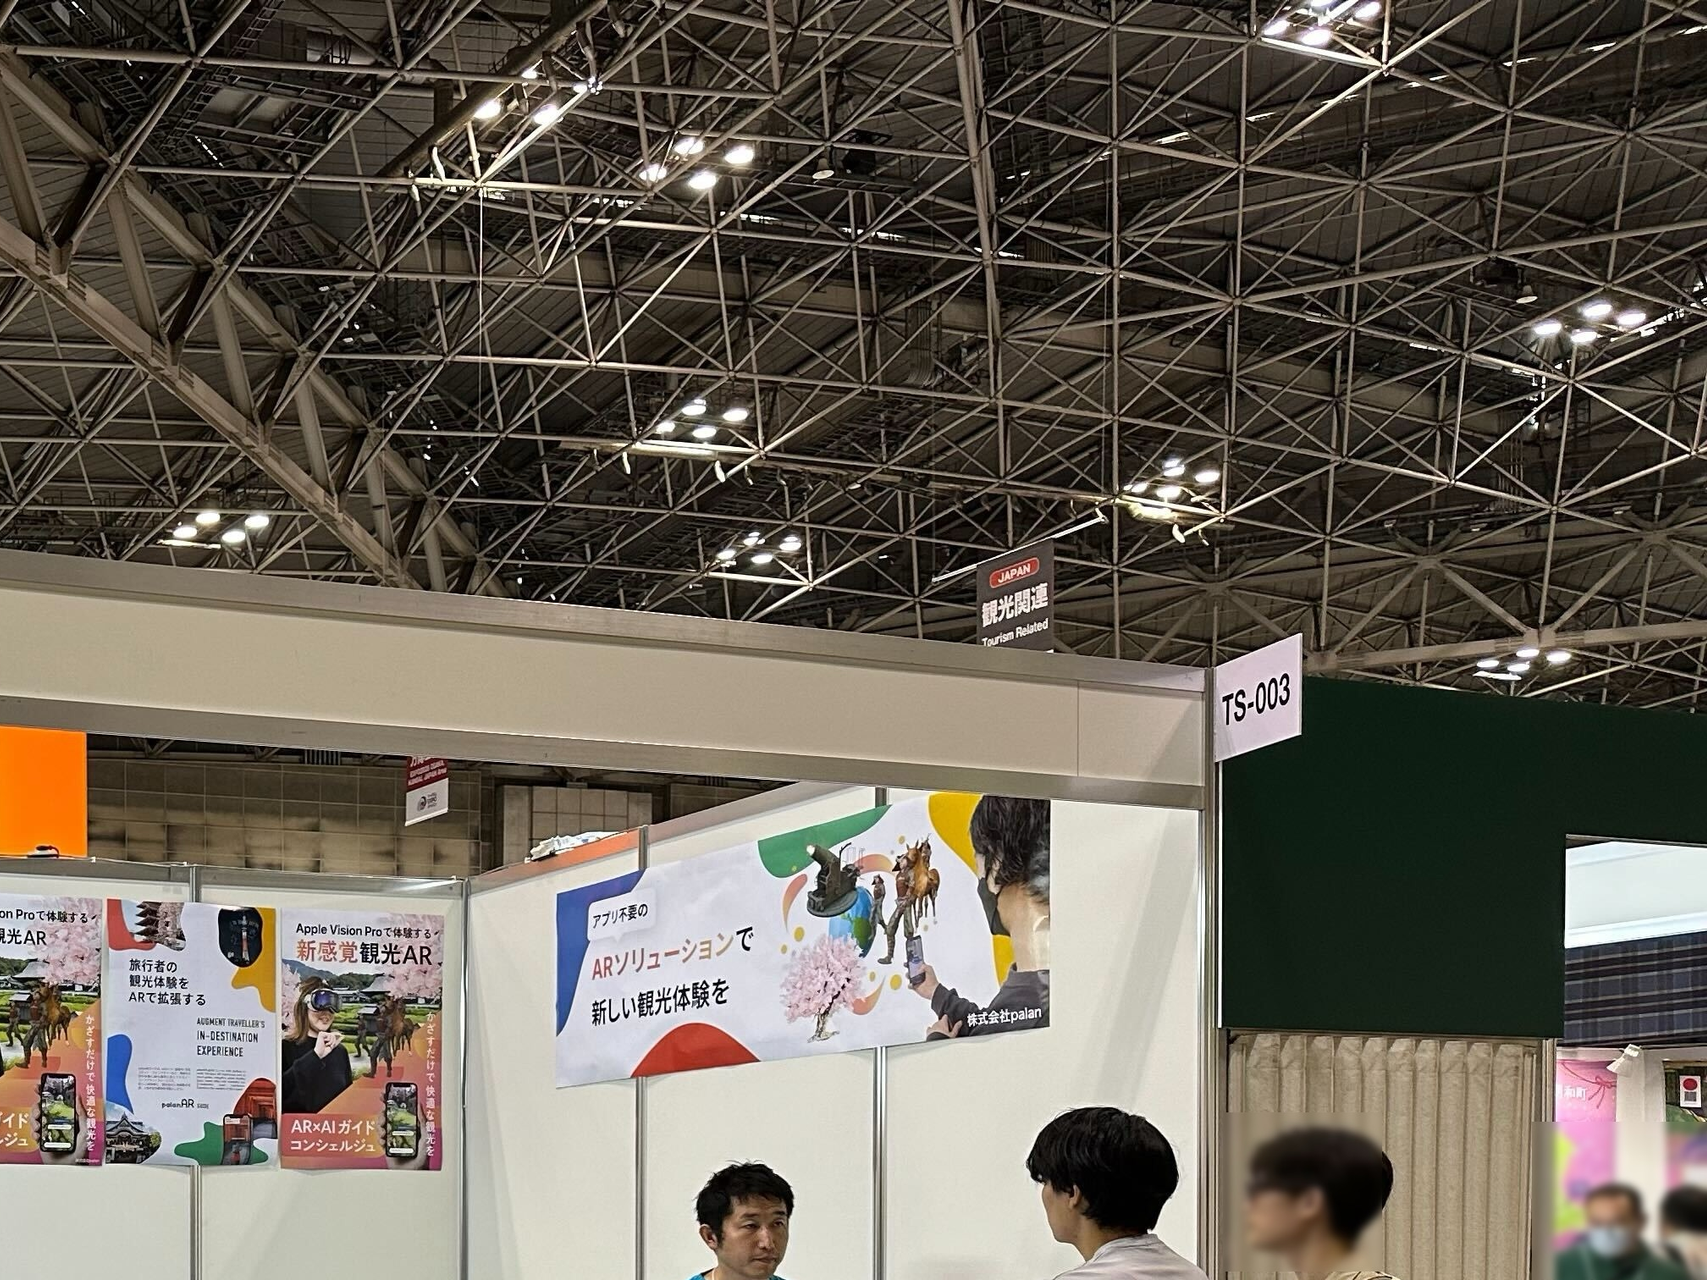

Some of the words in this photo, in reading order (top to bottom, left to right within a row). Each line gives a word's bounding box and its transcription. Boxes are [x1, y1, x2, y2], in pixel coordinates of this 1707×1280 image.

[997, 563, 1031, 584] JAPAN
[982, 582, 1049, 628] 観光関連
[982, 631, 1014, 647] Tourism
[1015, 618, 1049, 640] Related
[1222, 673, 1292, 726] TS-003
[592, 903, 649, 928] アプリ不要の
[296, 923, 327, 936] Apple
[330, 924, 362, 936] Vision
[297, 939, 432, 966] 新感覚観光AR
[592, 927, 755, 981] ARソリューションで
[129, 958, 177, 973] 旅行者の
[129, 975, 189, 990] 観光体験を
[128, 992, 206, 1006] ARで拡張する
[591, 977, 730, 1027] 新しい観光体験を
[196, 1017, 225, 1027] AUGMENT
[227, 1018, 265, 1028] TRAVELLER'S
[967, 1006, 1043, 1028] 株式会社palan
[196, 1030, 258, 1043] IN-DESTINATION
[196, 1045, 244, 1057] EXPERIENCE
[290, 1139, 376, 1152] コンシェルジュ
